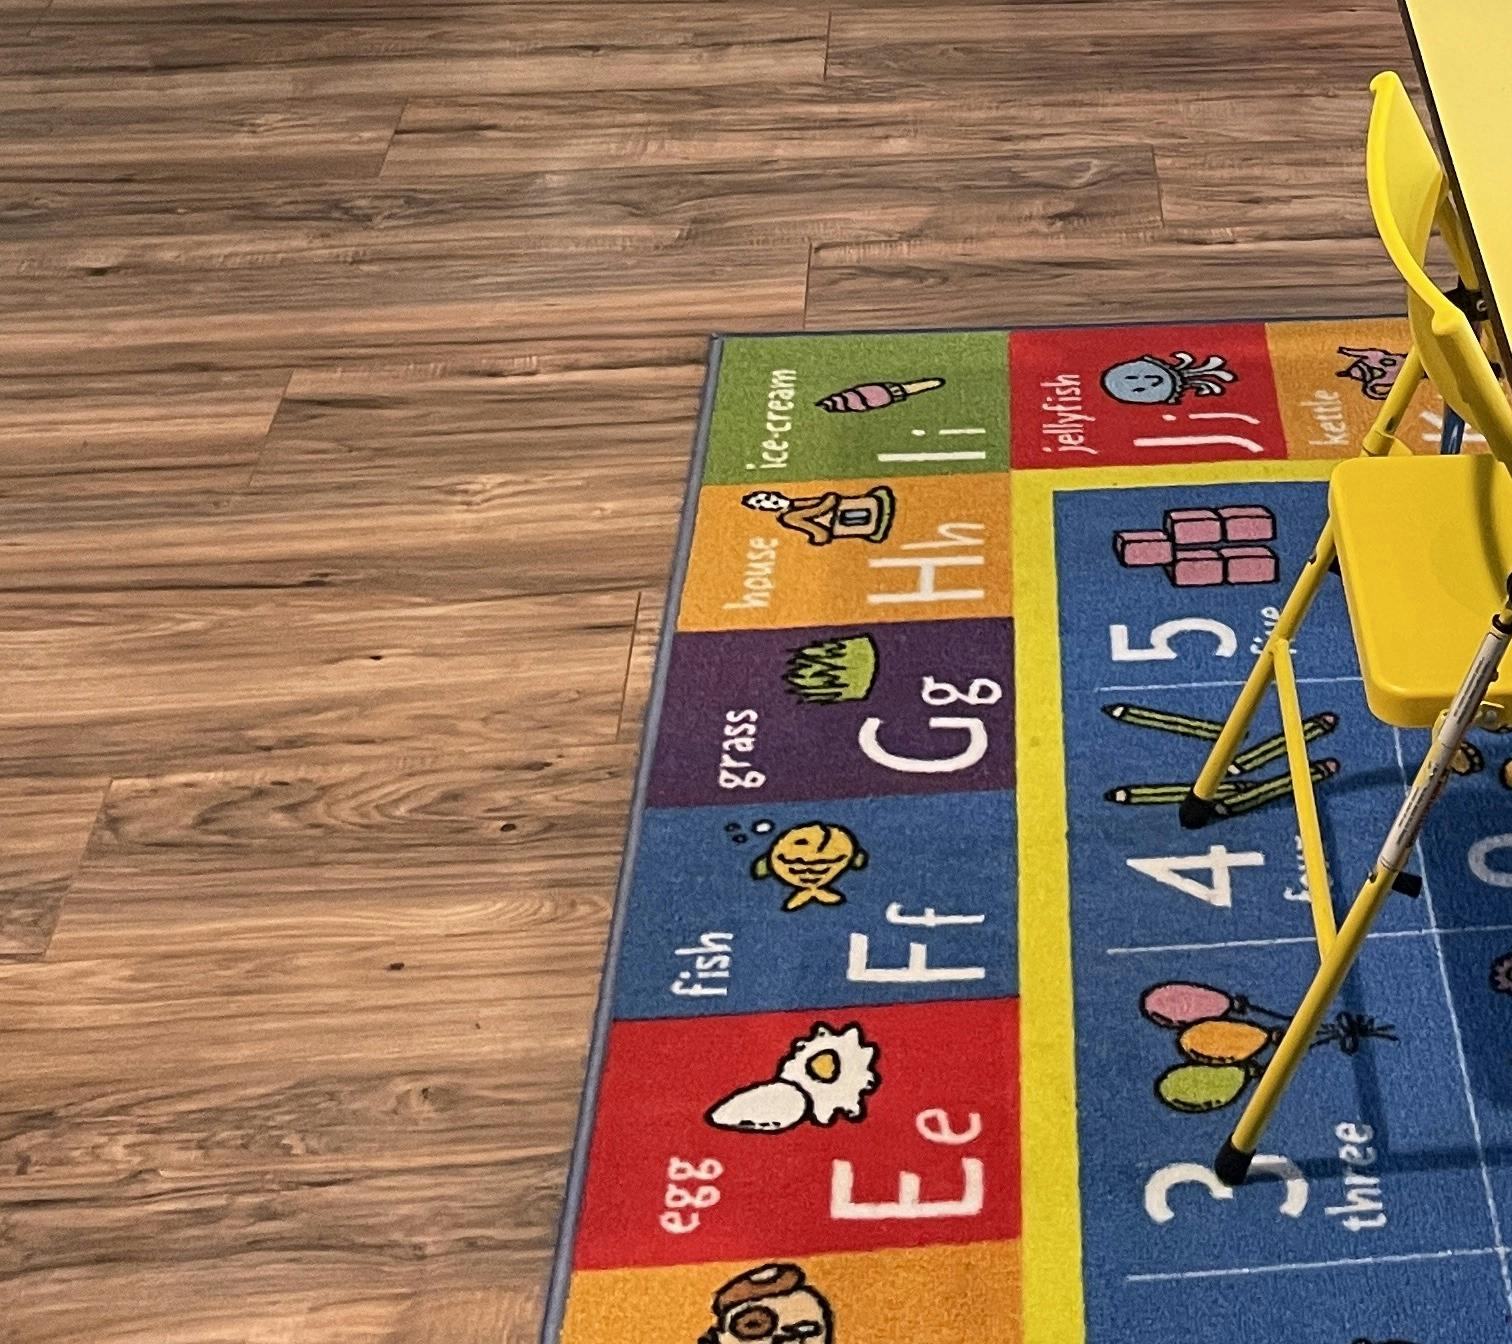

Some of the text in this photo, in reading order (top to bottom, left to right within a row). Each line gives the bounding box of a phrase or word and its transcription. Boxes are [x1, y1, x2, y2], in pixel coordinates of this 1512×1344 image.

[745, 368, 799, 471] ice-cream
[1039, 373, 1098, 455] jellyfish
[1133, 413, 1264, 454] Jj
[1300, 390, 1349, 446] kettle
[722, 534, 778, 610] house
[866, 520, 988, 607] Hh
[1109, 617, 1237, 662] 5
[718, 707, 764, 789] grass
[858, 676, 1002, 774] Gg
[1126, 845, 1264, 907] 4
[673, 930, 734, 997] fish
[846, 902, 986, 985] Ff
[659, 1155, 725, 1234] egg
[832, 1107, 984, 1222] Ee
[1144, 1154, 1309, 1224] 3
[1324, 1120, 1388, 1233] three
